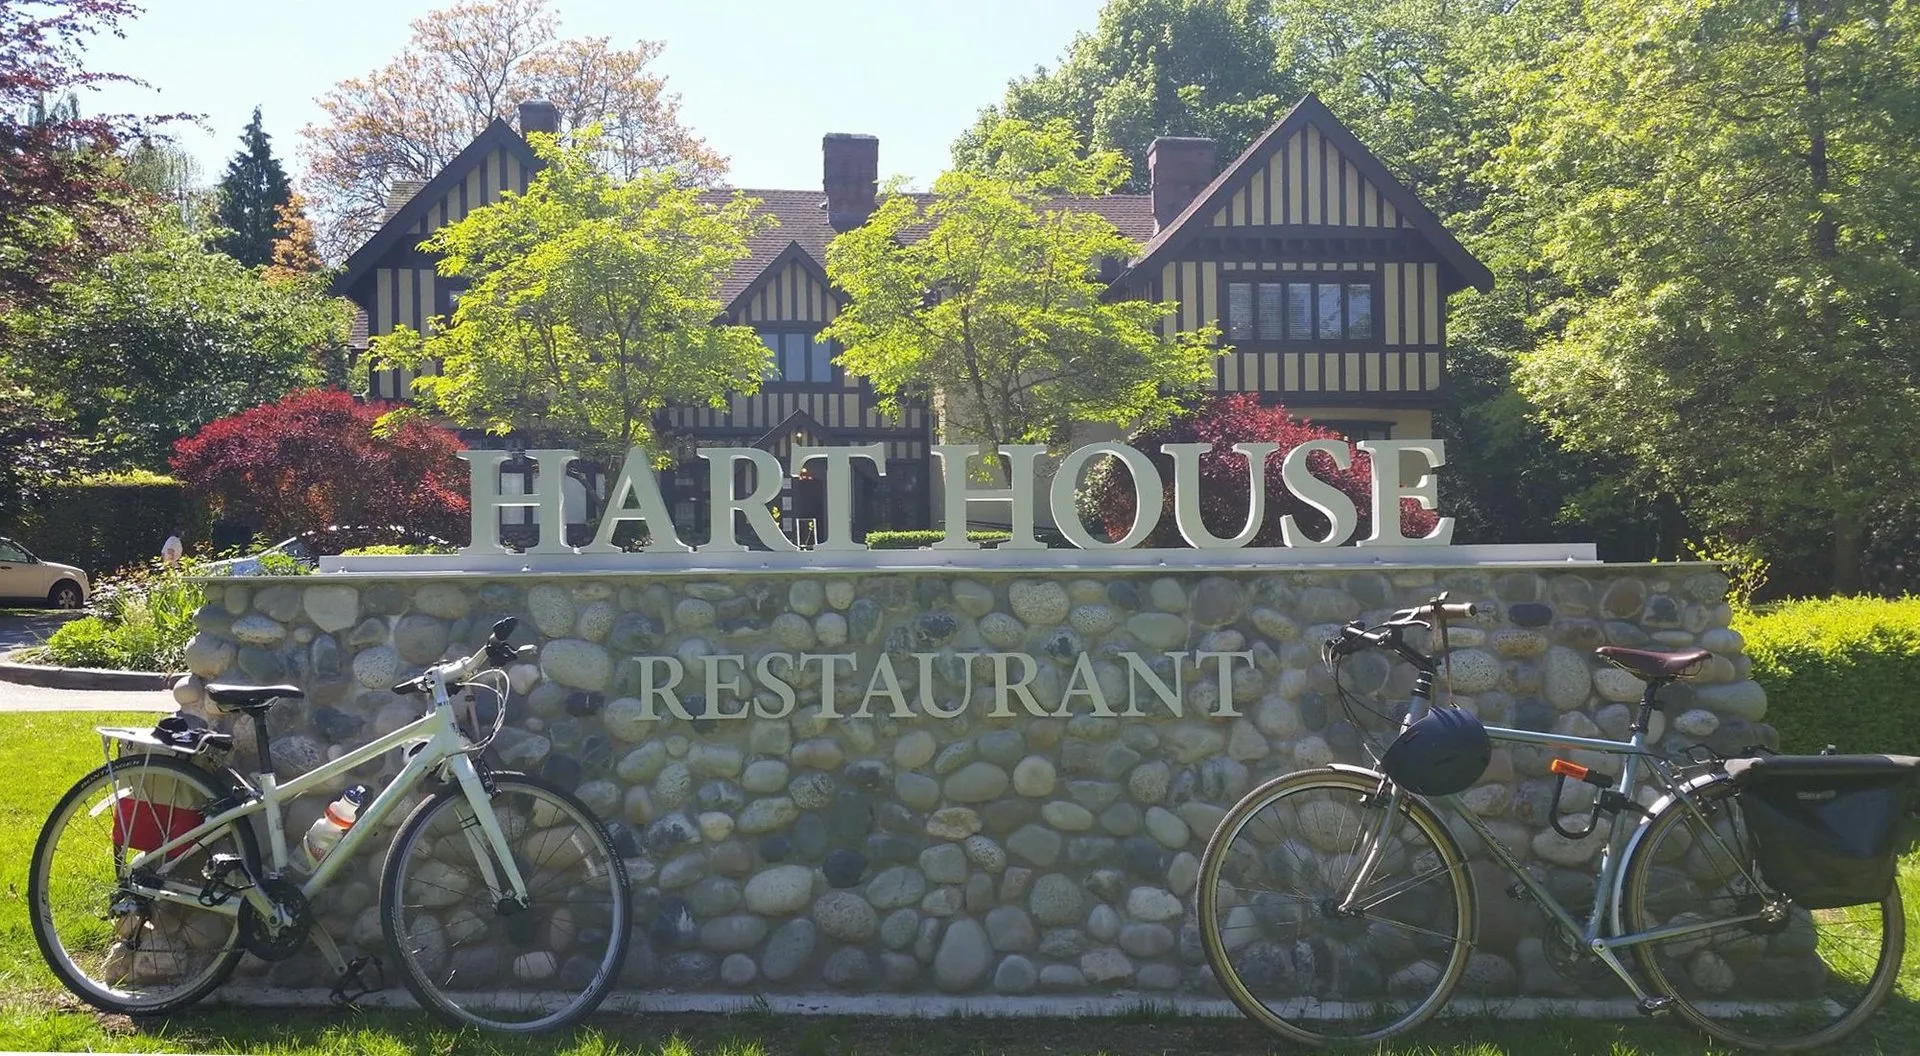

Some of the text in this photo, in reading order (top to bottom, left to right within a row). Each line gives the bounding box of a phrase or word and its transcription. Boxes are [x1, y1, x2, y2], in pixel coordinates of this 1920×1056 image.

[456, 439, 1455, 554] HART HOUSE
[633, 651, 1254, 721] RESTAURANT
